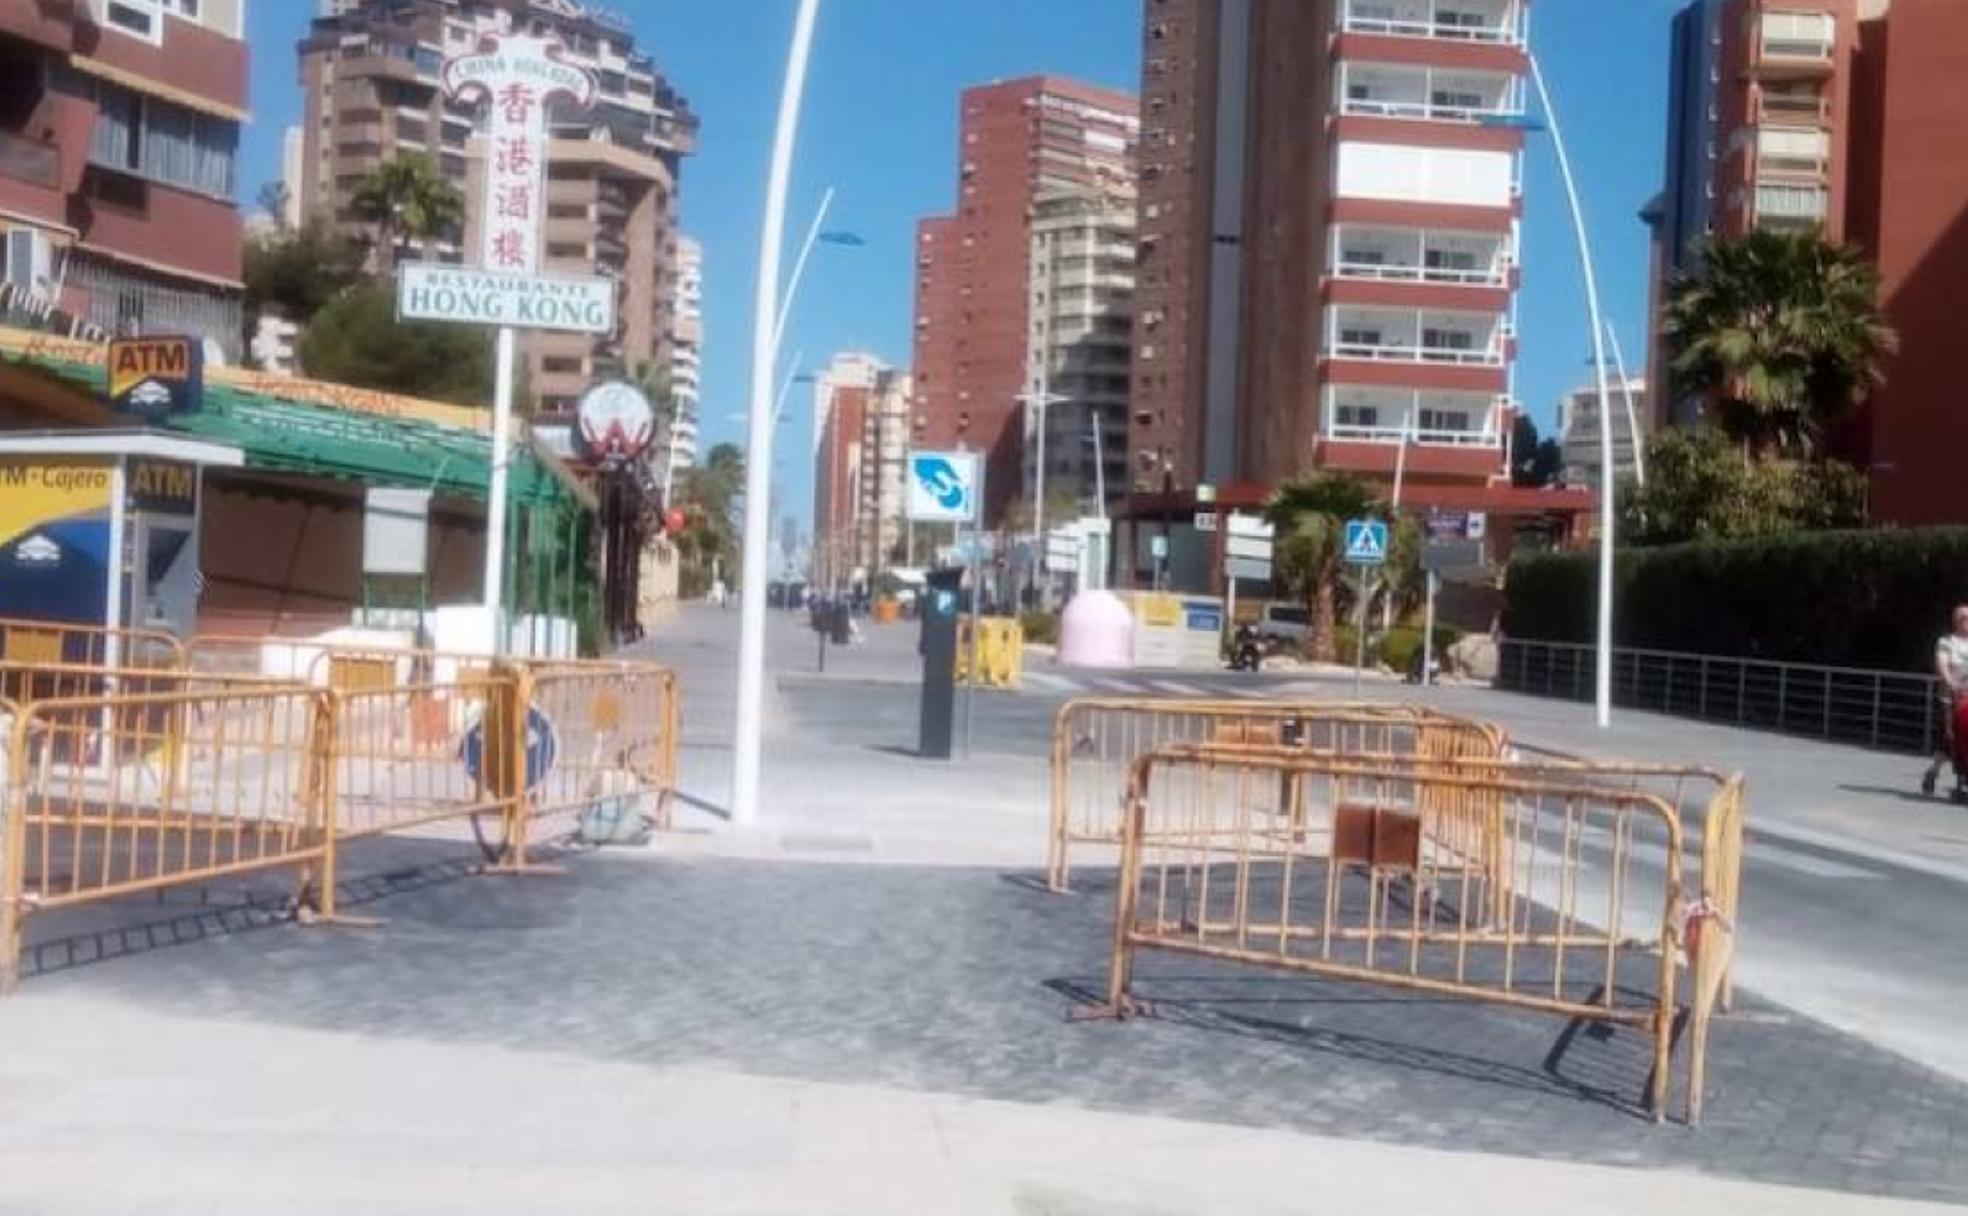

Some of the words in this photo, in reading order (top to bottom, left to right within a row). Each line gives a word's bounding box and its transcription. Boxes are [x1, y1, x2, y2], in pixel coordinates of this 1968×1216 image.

[427, 273, 589, 298] RESTAURANTE
[411, 286, 501, 318] HONG
[517, 297, 603, 326] KONG
[117, 343, 185, 373] ATM
[42, 464, 108, 492] Cajero
[132, 463, 193, 496] ATM
